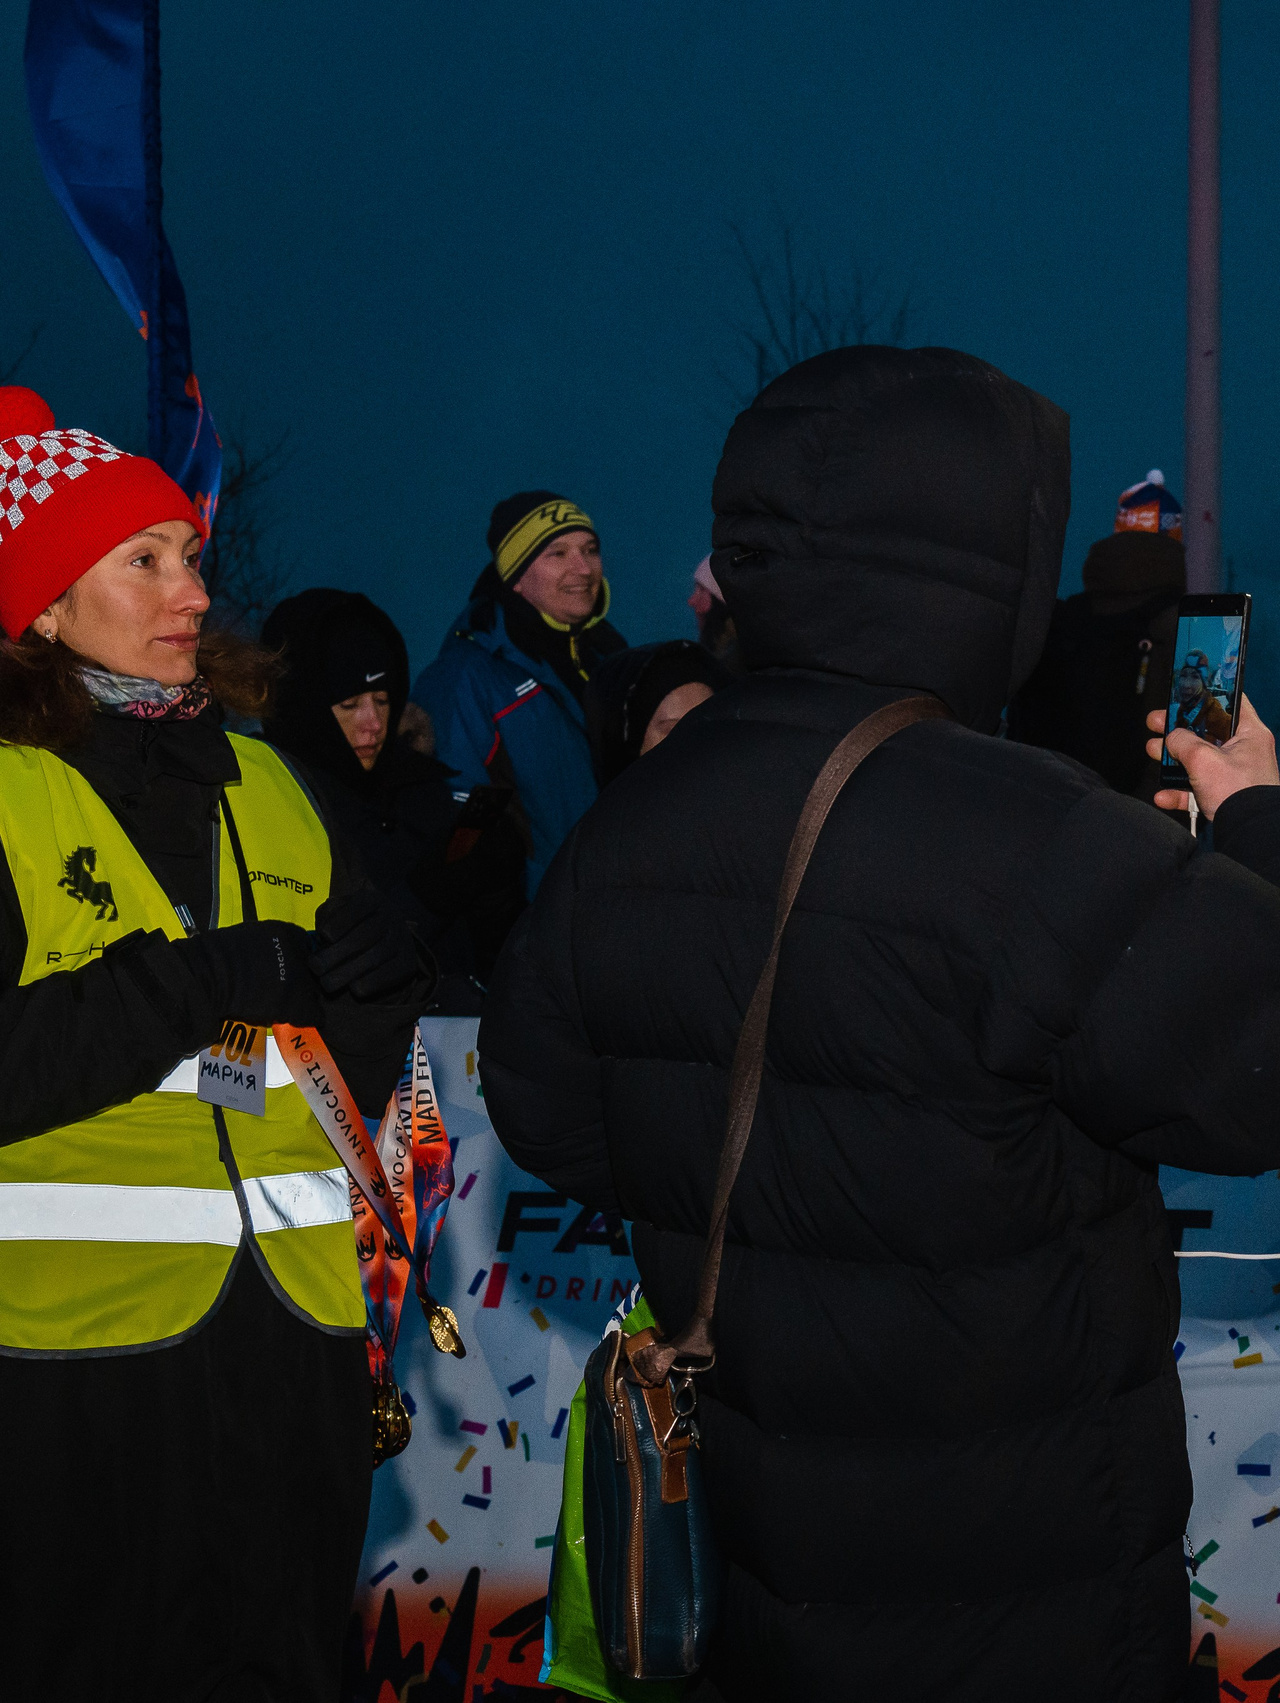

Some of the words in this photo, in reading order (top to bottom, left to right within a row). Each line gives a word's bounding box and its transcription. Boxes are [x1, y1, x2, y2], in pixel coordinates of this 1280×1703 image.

[247, 870, 314, 895] ОЛОНТЕР
[200, 1060, 256, 1091] МАРИЯ
[415, 1034, 430, 1080] FOX
[290, 1034, 367, 1160] INVOCATION
[415, 1088, 444, 1145] MAD
